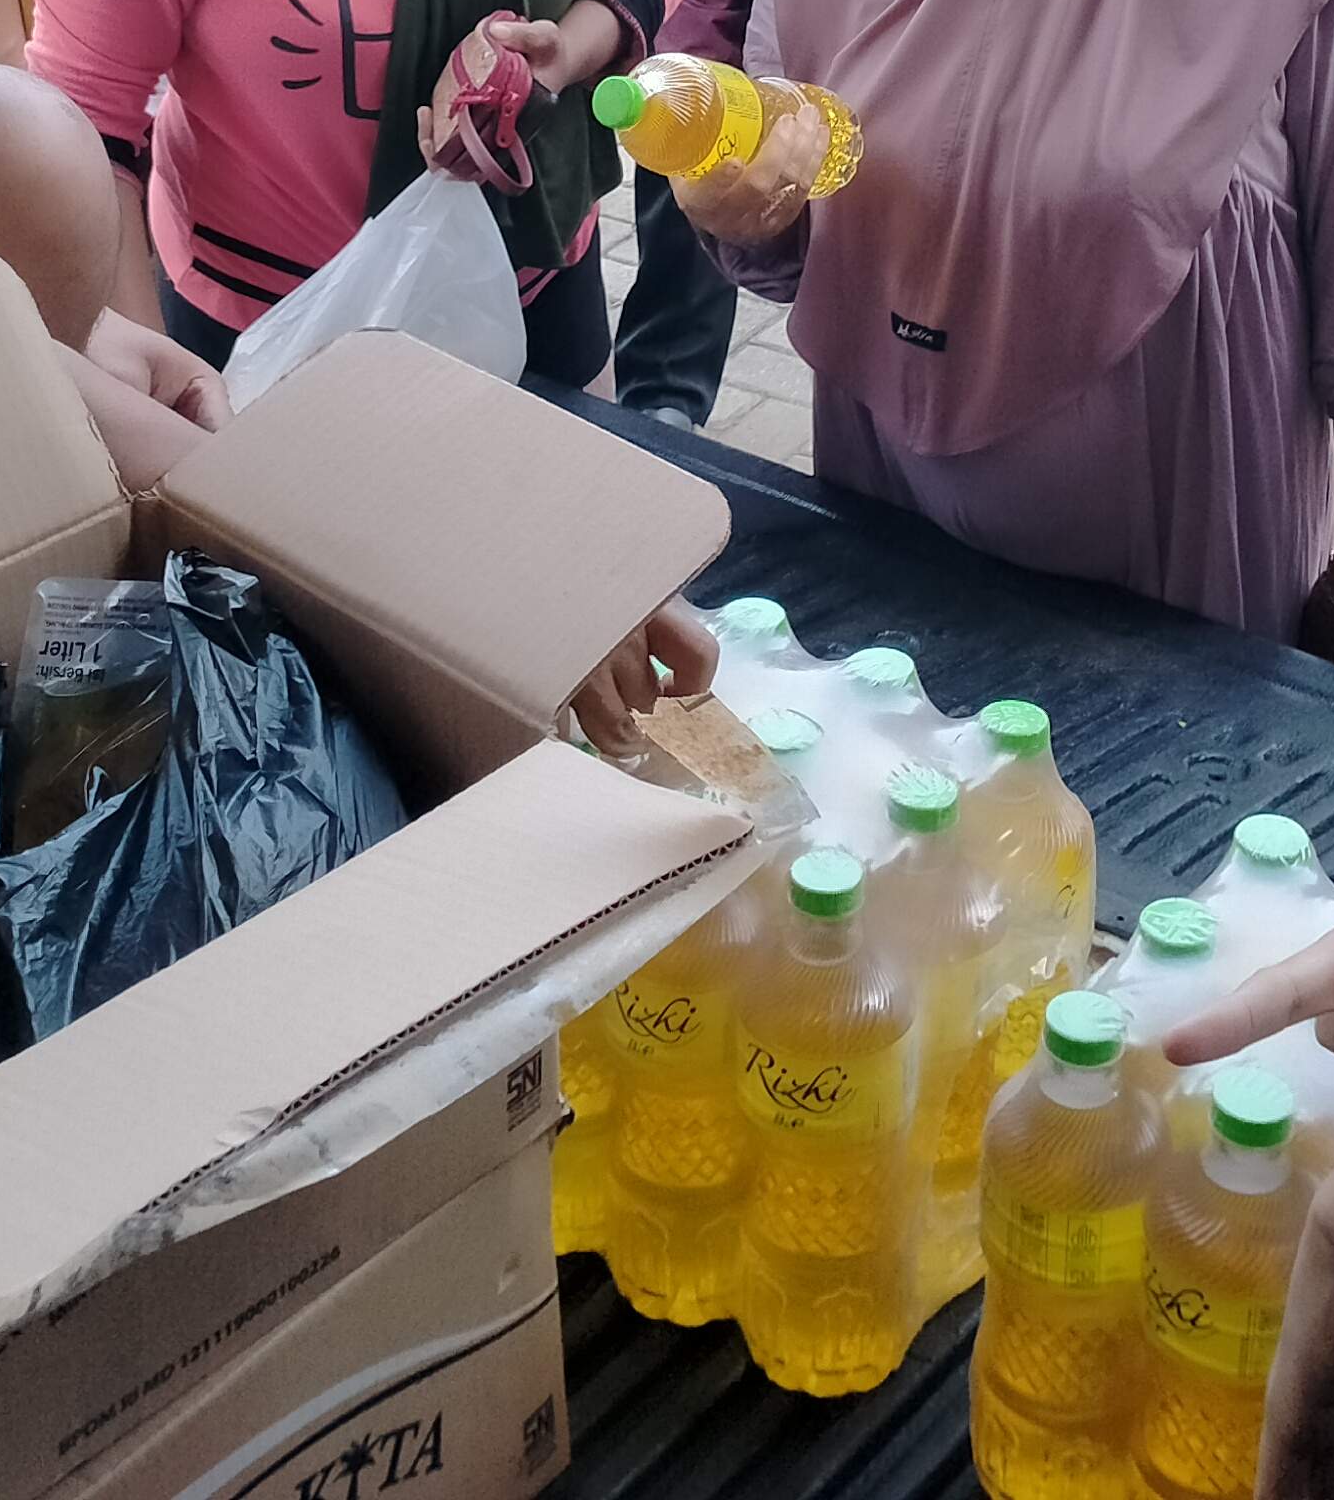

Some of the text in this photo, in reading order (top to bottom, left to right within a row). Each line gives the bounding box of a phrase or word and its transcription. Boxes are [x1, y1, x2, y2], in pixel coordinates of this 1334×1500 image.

[38, 639, 103, 663] 1 Liter
[746, 1042, 855, 1114] Rizki
